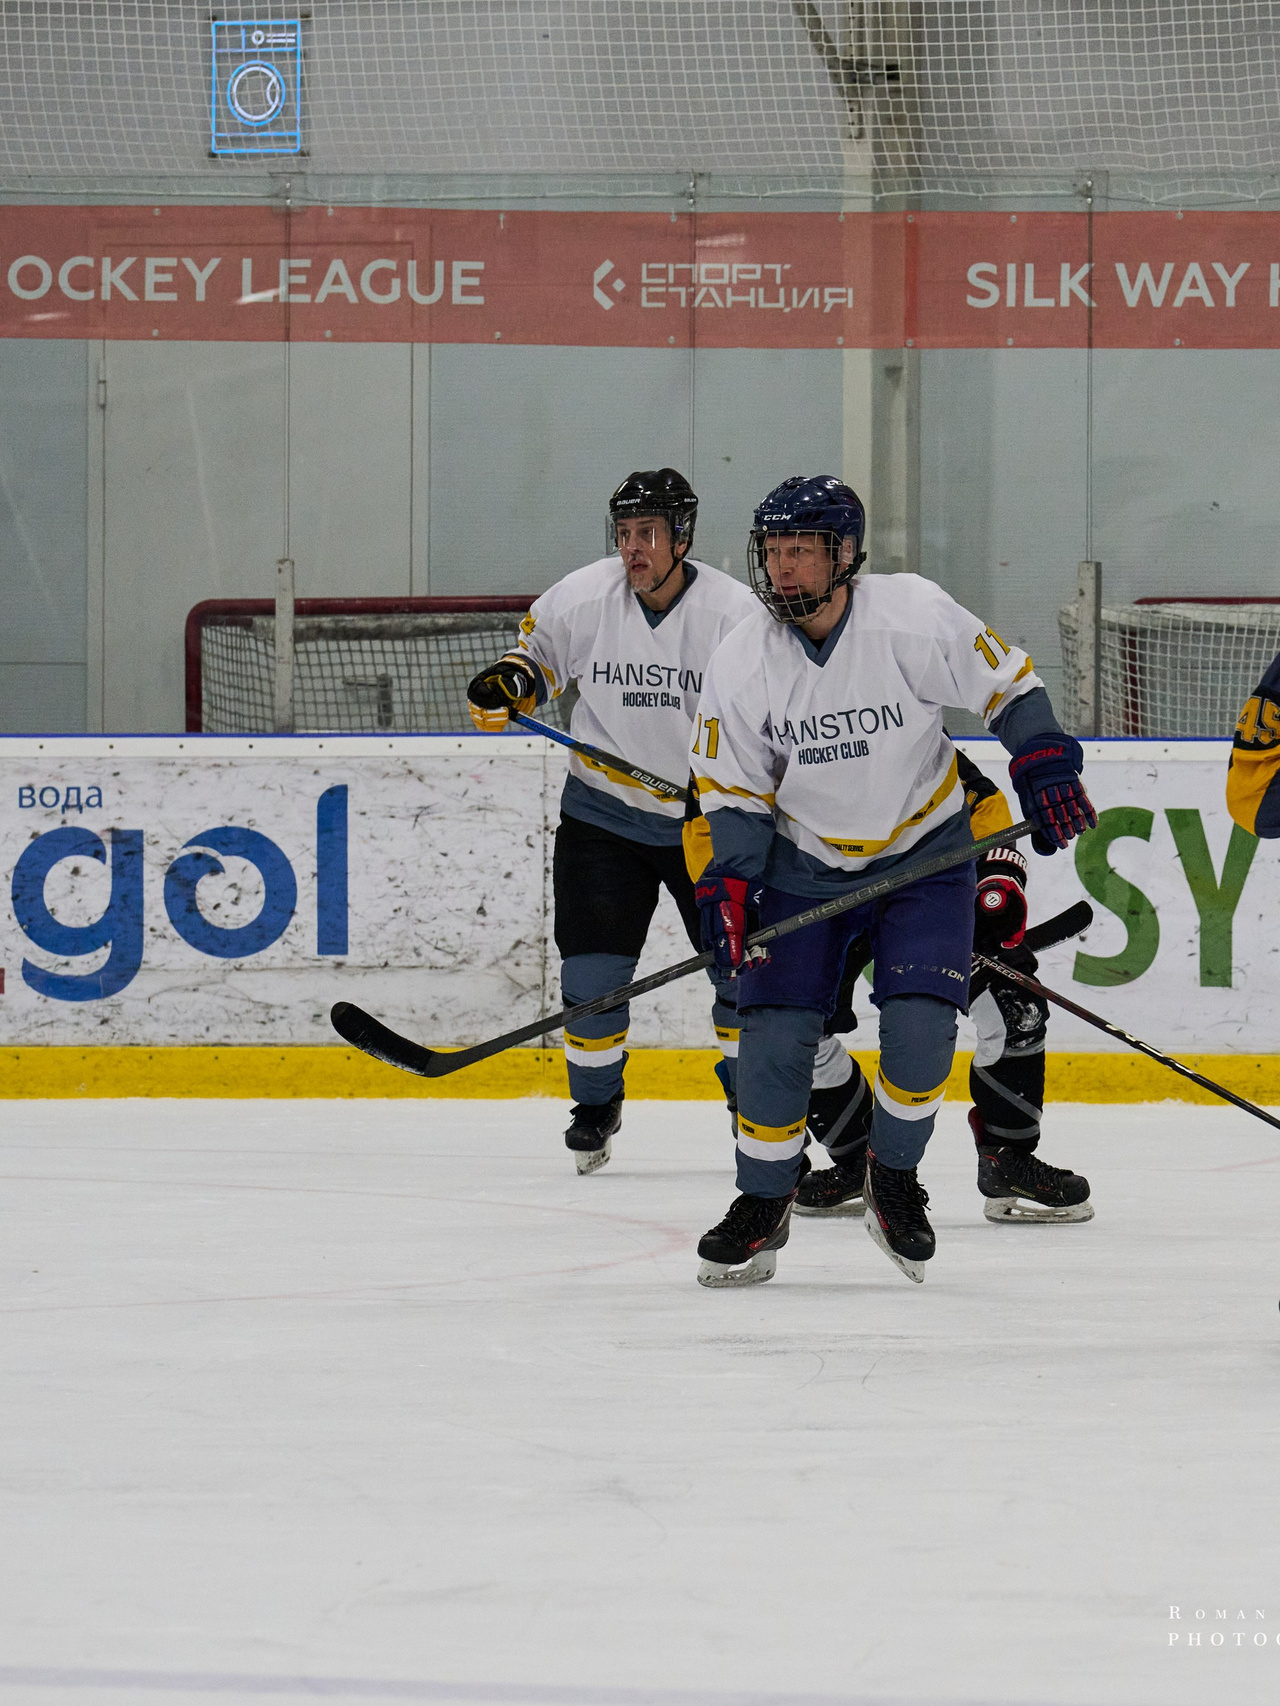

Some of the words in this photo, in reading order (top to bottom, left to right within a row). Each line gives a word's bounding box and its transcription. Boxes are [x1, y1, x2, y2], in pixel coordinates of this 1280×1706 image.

[241, 257, 486, 306] LEAGUE
[965, 261, 1096, 310] SILK
[1115, 261, 1252, 309] WAY
[641, 285, 854, 313] СТАНЦИЯ
[763, 513, 792, 521] CCM
[974, 624, 1011, 671] 11
[622, 691, 659, 708] HOCKEY
[660, 692, 681, 711] CLUB
[798, 745, 841, 765] HOCKEY
[841, 738, 870, 760] CLUB
[630, 769, 678, 797] BAUER
[17, 784, 103, 815] вода
[11, 783, 349, 1002] gol
